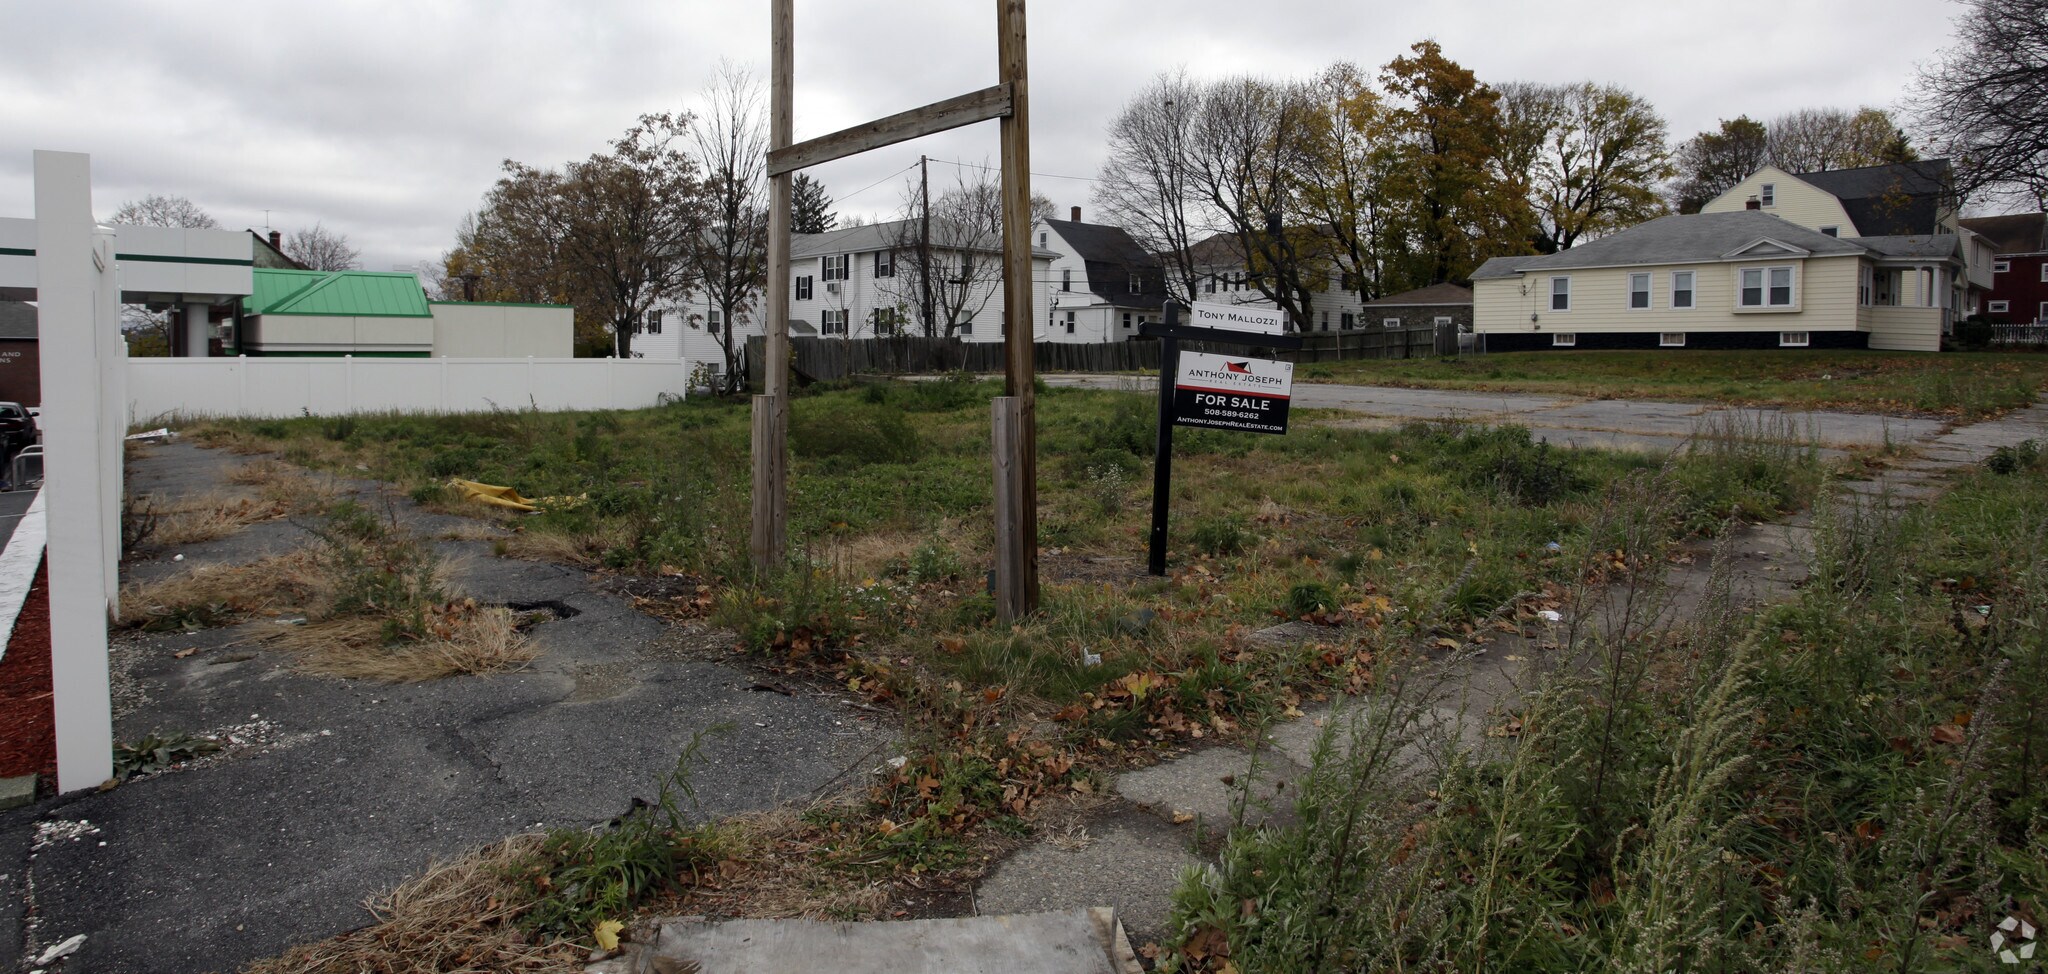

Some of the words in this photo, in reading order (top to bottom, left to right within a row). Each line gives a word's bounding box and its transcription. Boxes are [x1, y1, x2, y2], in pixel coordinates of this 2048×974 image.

[1188, 369, 1239, 380] ANTHONY
[1242, 374, 1283, 385] JOSEPH
[1195, 393, 1226, 406] FOR
[1230, 397, 1270, 411] SALE
[1204, 408, 1259, 419] 508-589-6262
